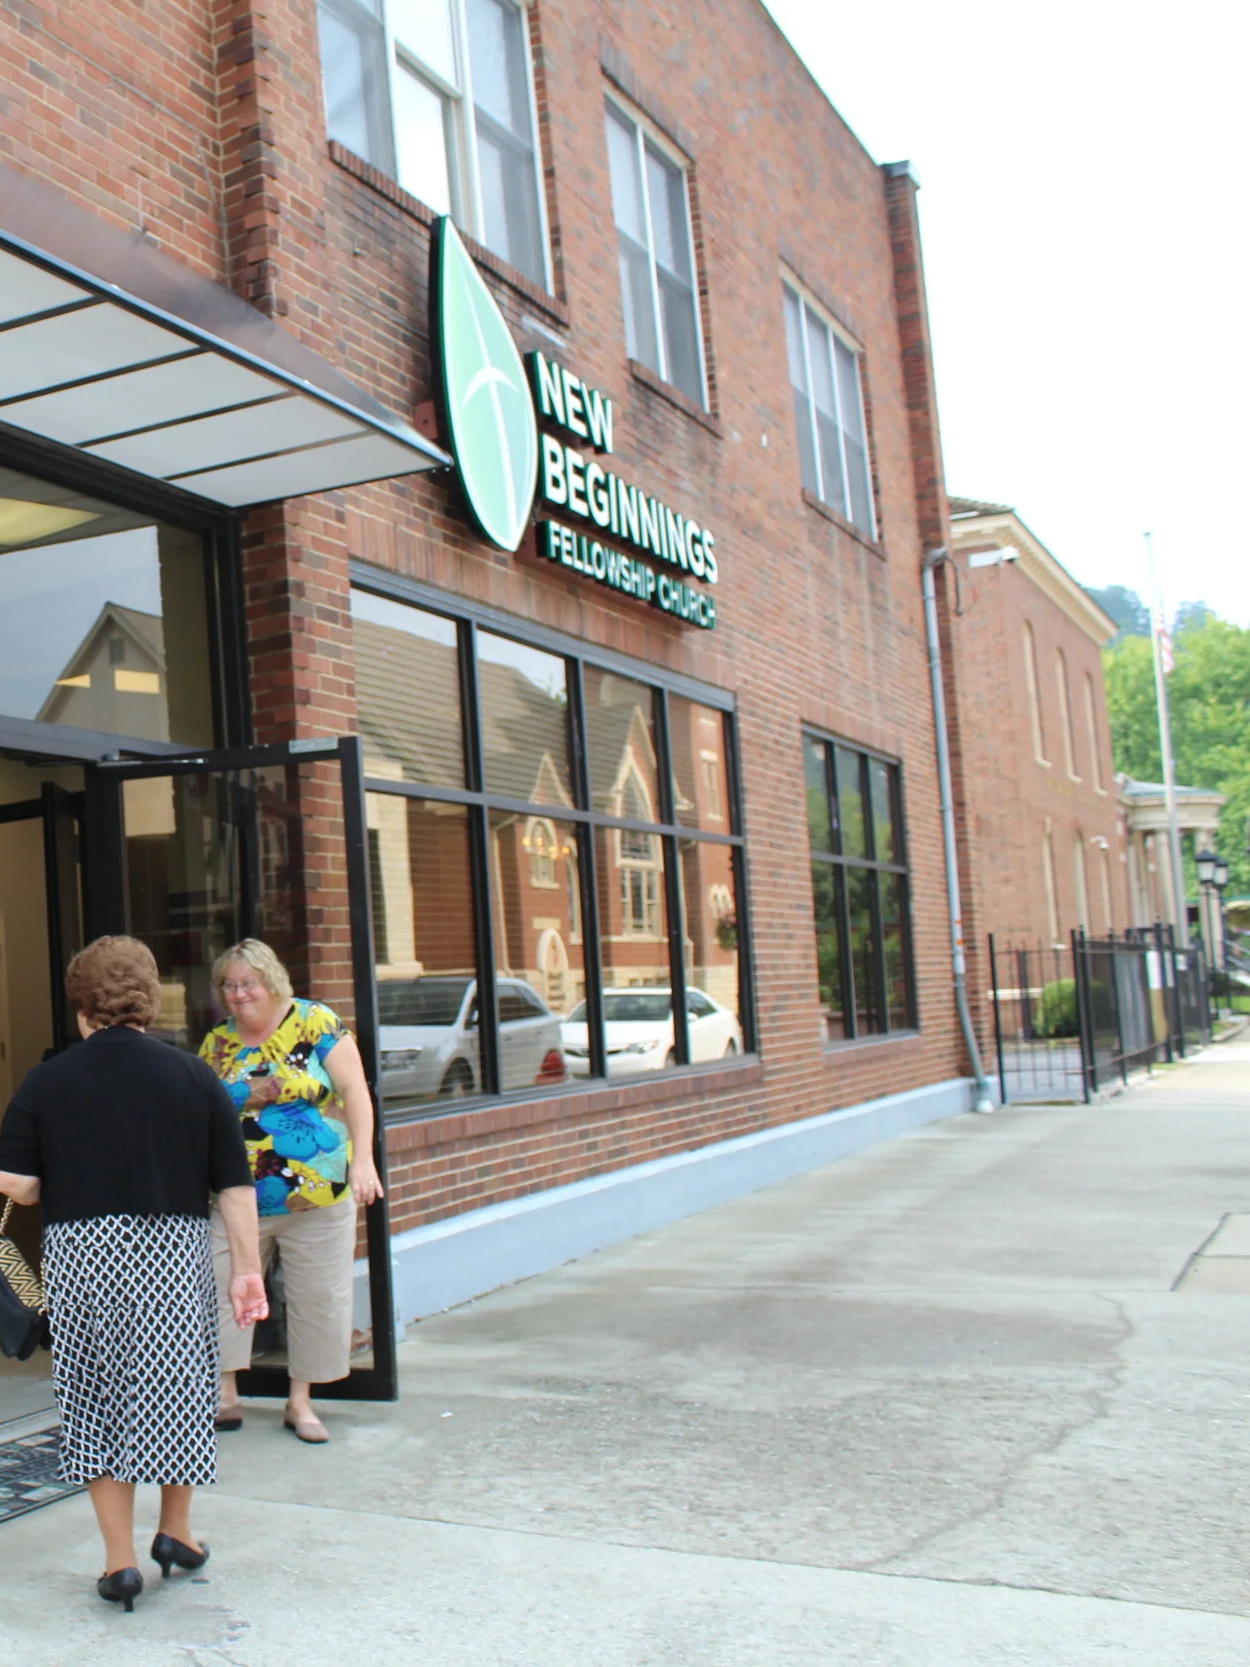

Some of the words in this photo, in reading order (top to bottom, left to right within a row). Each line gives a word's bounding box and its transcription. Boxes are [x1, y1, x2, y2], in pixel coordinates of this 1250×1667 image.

[533, 350, 613, 454] NEW
[541, 432, 718, 584] BEGINNINGS
[548, 519, 656, 601] FELLOWSHIP
[657, 573, 717, 629] CHURCH
